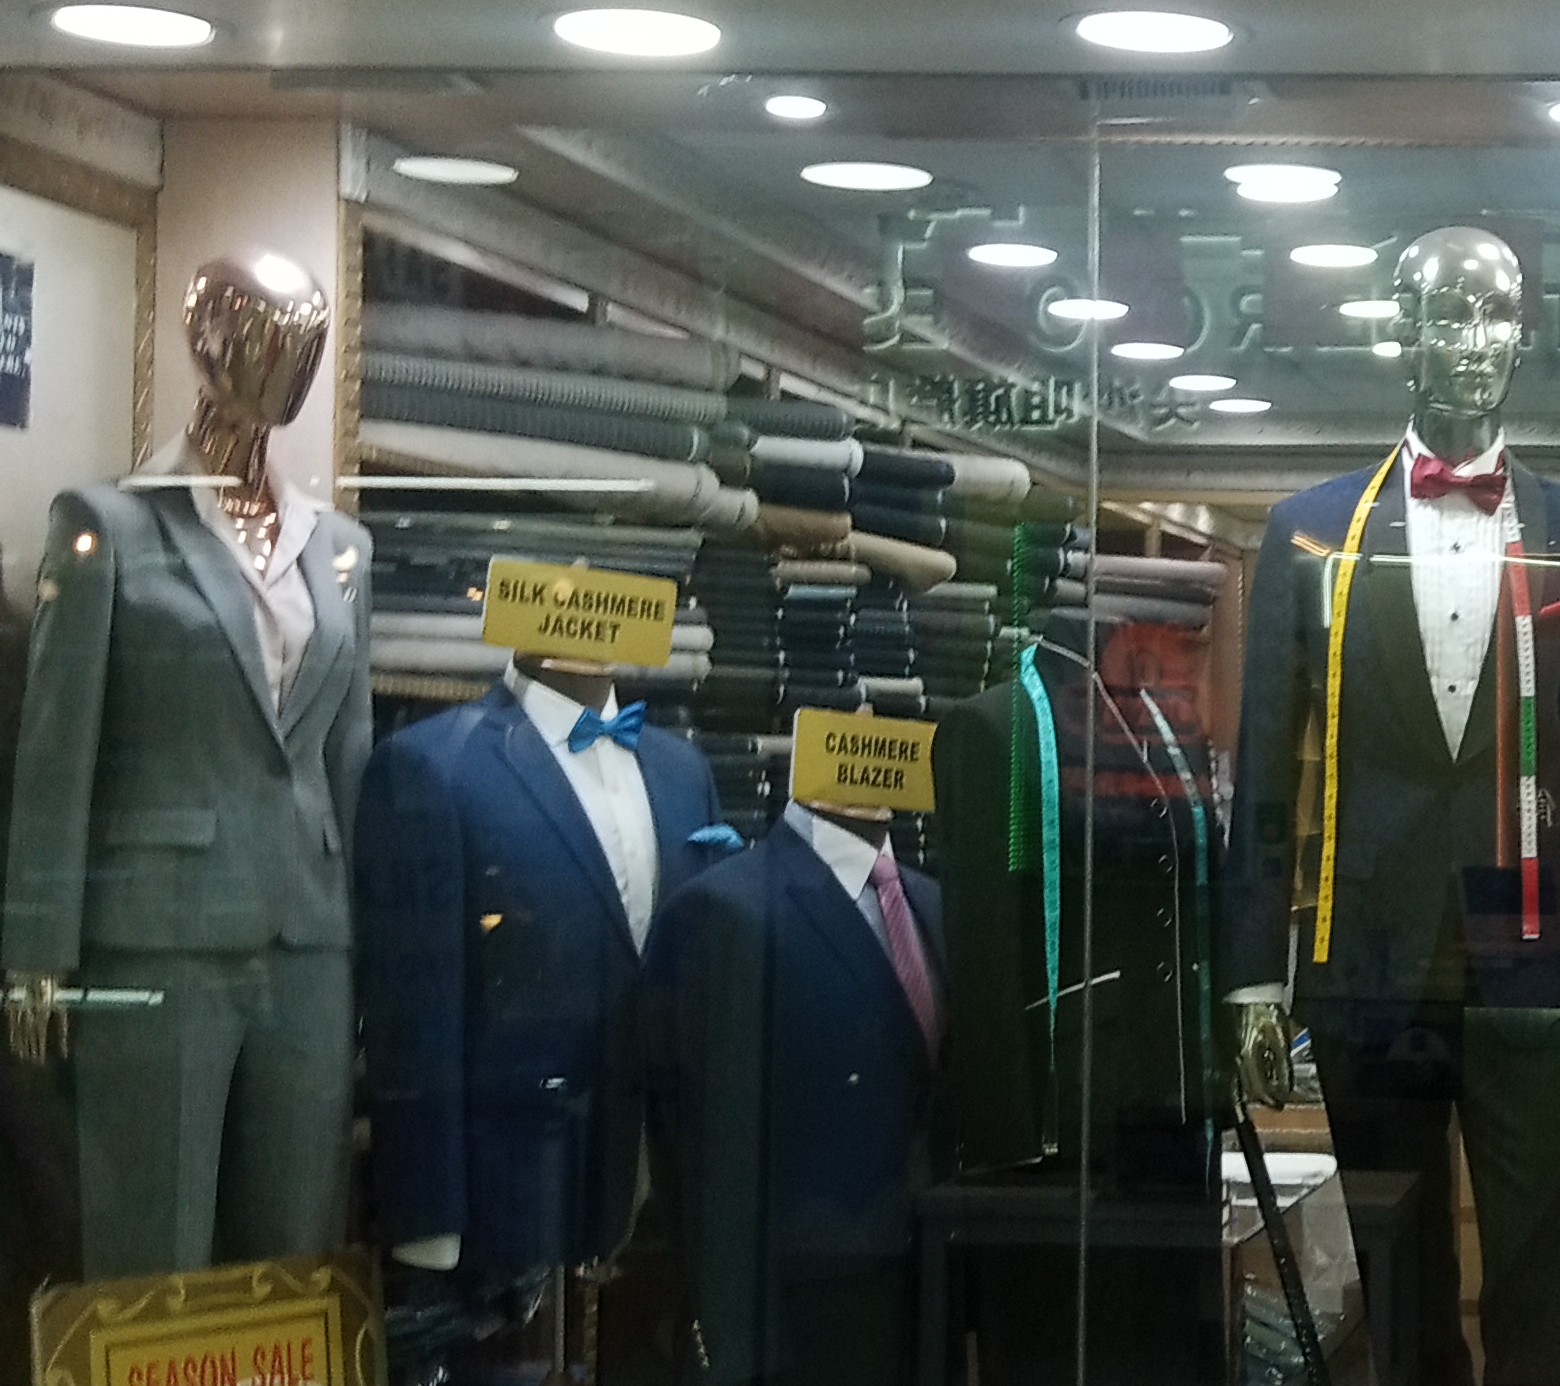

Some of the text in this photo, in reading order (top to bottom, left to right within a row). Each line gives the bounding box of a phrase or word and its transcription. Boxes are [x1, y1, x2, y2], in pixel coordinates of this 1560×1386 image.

[498, 579, 666, 622] SILK CASHMERE
[537, 613, 622, 645] JACKET
[825, 732, 921, 762] CASHMERE
[836, 761, 905, 791] BLAZER
